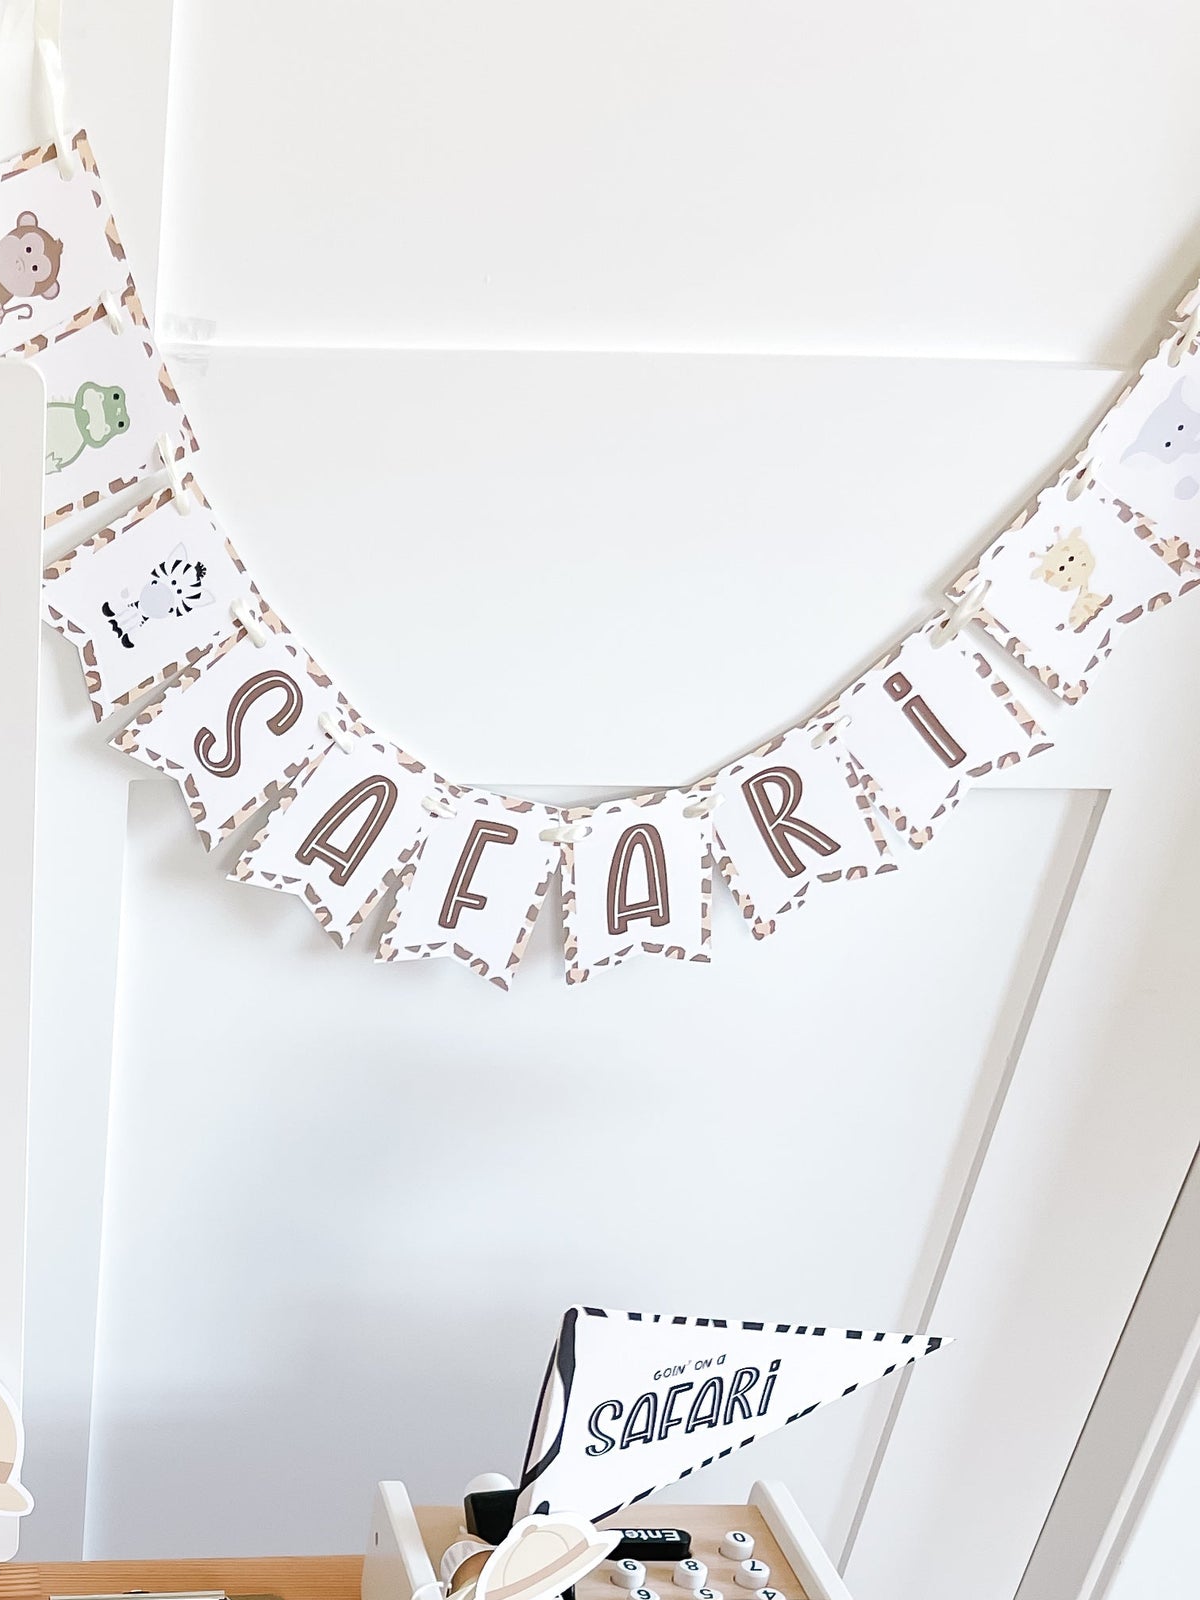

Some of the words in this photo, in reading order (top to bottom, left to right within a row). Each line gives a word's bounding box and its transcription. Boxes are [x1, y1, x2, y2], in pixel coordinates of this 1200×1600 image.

[694, 1357, 713, 1371] ON
[622, 1529, 681, 1542] Ente
[732, 1532, 746, 1543] 0
[684, 1559, 699, 1571] 8
[749, 1561, 763, 1572] 7
[699, 1588, 714, 1600] 5
[762, 1589, 776, 1600] 4
